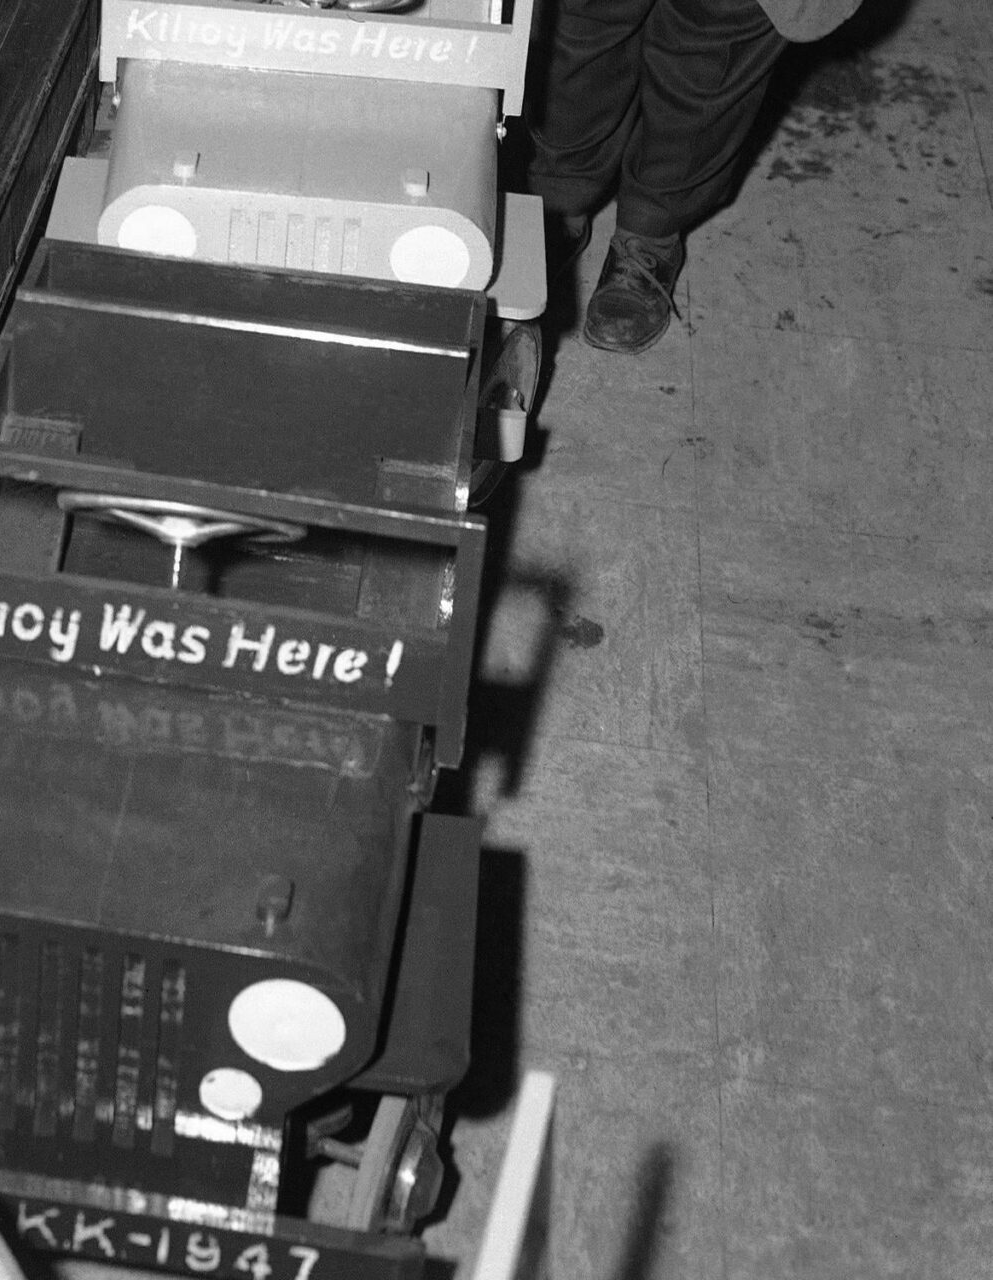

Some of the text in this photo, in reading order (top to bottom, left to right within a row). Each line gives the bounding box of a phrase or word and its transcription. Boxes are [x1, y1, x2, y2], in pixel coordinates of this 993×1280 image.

[126, 8, 247, 58] Kilroy
[262, 17, 342, 54] Was
[99, 602, 212, 665] Was
[16, 1201, 321, 1280] KK-1947
